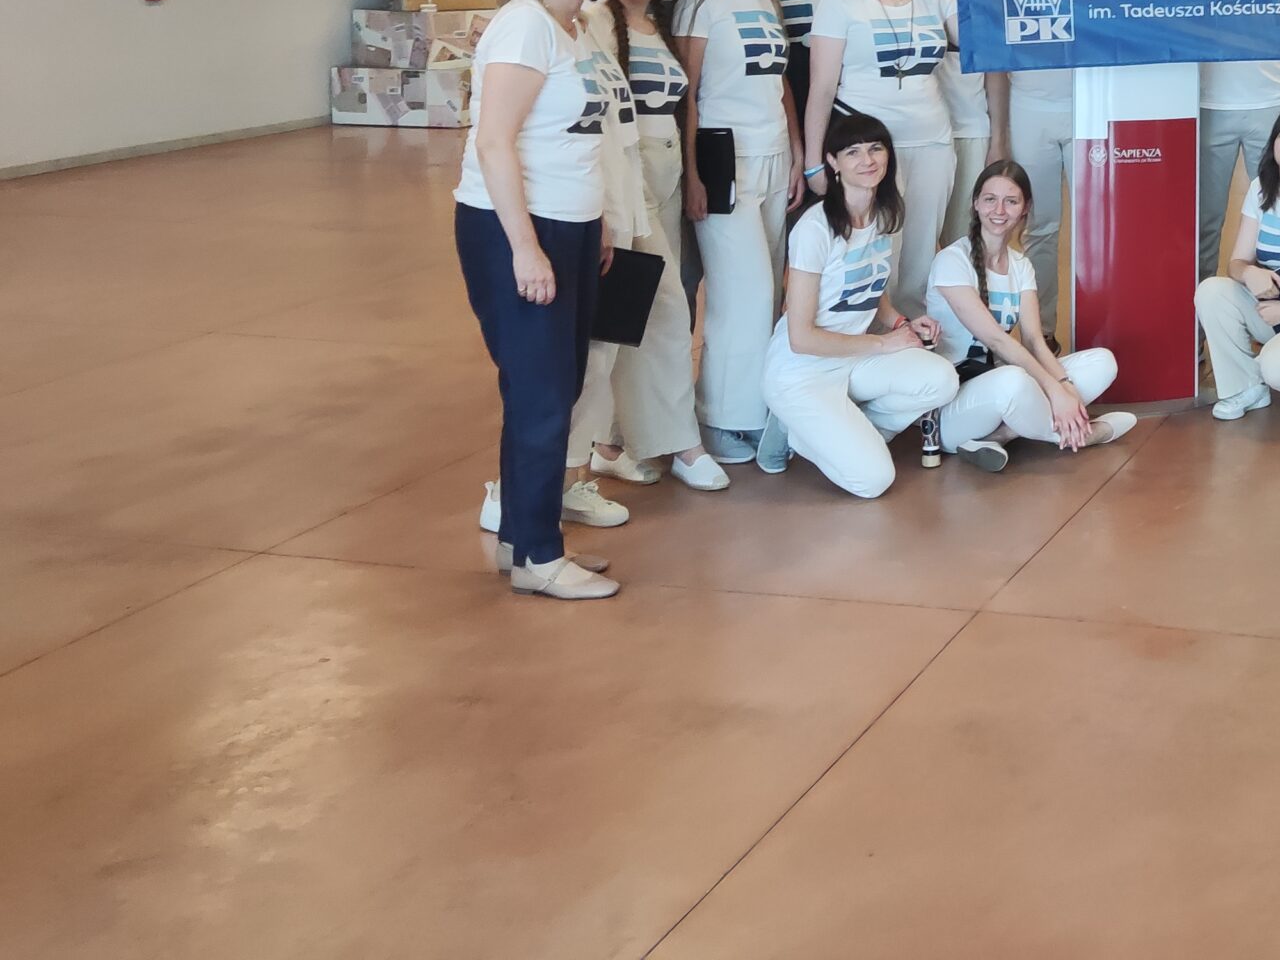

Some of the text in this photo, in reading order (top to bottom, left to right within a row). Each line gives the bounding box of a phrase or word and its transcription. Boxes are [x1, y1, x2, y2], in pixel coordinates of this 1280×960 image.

[1088, 4, 1117, 20] im.
[1119, 2, 1205, 18] Tadeusza
[1009, 19, 1072, 41] PK
